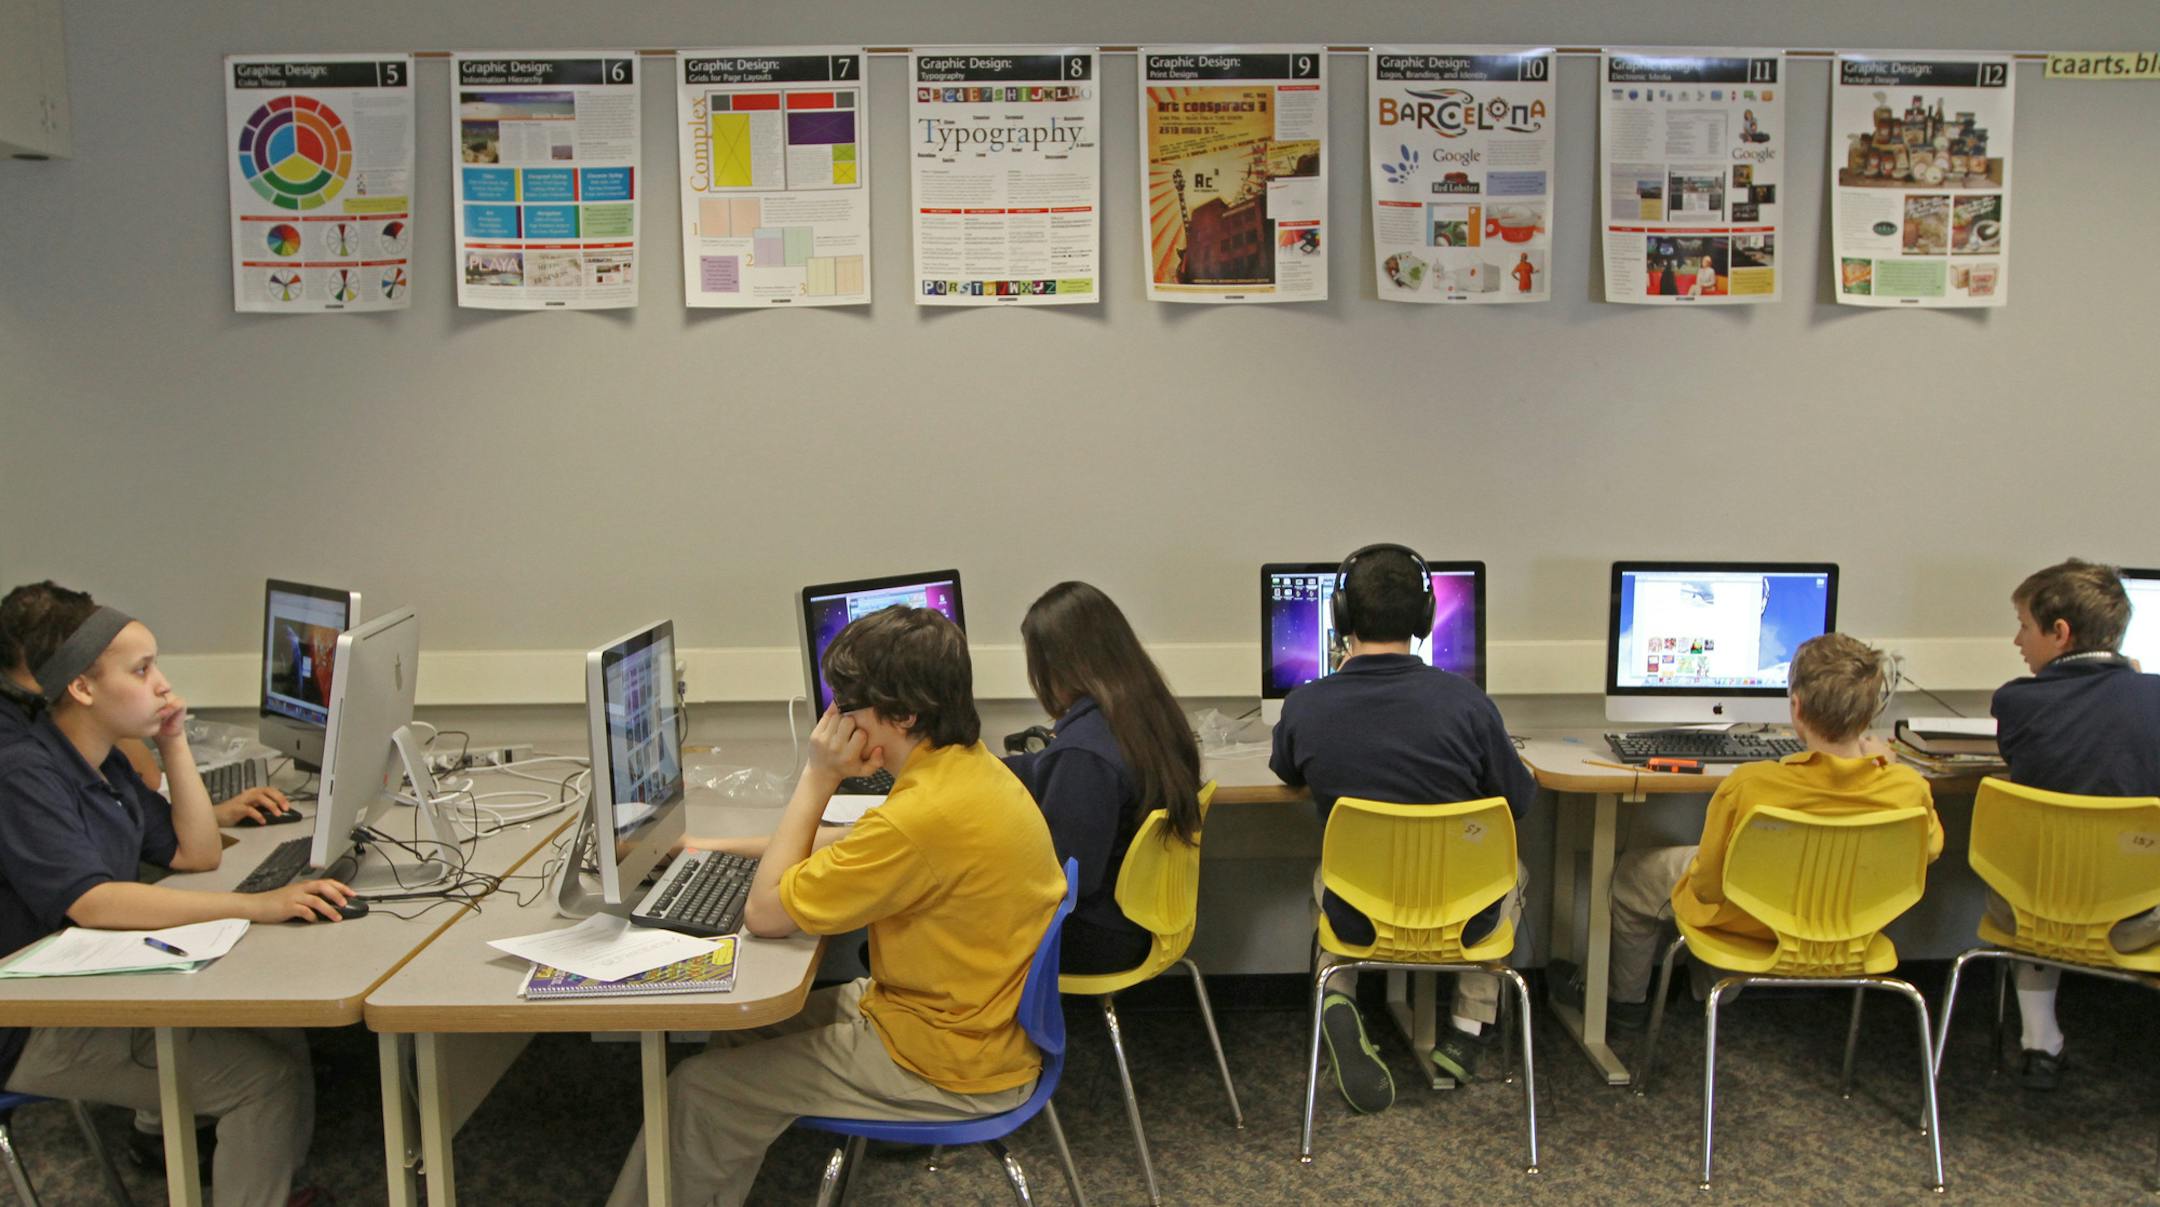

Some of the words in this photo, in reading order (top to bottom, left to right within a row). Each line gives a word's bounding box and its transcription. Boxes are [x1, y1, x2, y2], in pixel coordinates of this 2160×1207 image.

[462, 61, 506, 75] Graphic
[511, 60, 553, 76] Design:
[688, 59, 733, 73] Graphic
[737, 58, 780, 72] Design:
[838, 58, 850, 78] 7
[921, 57, 966, 71] Graphic
[969, 57, 1012, 71] Design:
[1070, 57, 1083, 77] 8
[1150, 56, 1194, 69] Graphic
[1199, 55, 1241, 70] Design:
[1298, 56, 1311, 76] 9
[1380, 56, 1424, 70] Graphic
[1428, 56, 1471, 71] Design:
[1525, 59, 1545, 79] 10
[1844, 62, 1888, 75] Graphic
[1891, 62, 1933, 77] Design:
[2051, 52, 2160, 75] caarts.bl
[237, 63, 281, 78] Graphic
[285, 63, 328, 79] Design:
[386, 64, 399, 84] 5
[611, 61, 625, 81] 6
[688, 74, 709, 82] Grids
[711, 74, 721, 82] for
[723, 74, 741, 83] Page
[743, 73, 772, 82] Layouts
[921, 72, 965, 81] Typography
[1150, 70, 1168, 78] Print
[1169, 70, 1198, 80] Designs
[1443, 70, 1458, 79] and
[1755, 61, 1771, 81] 11
[1984, 65, 2004, 85] 12
[918, 116, 1084, 153] Typography
[687, 96, 712, 192] Complex
[1432, 147, 1481, 166] Google
[1731, 147, 1776, 163] Google
[1433, 182, 1448, 193] Red
[1450, 182, 1479, 193] Lobster
[468, 254, 522, 273] PLAYA
[745, 253, 754, 267] 2
[799, 282, 807, 296] 3
